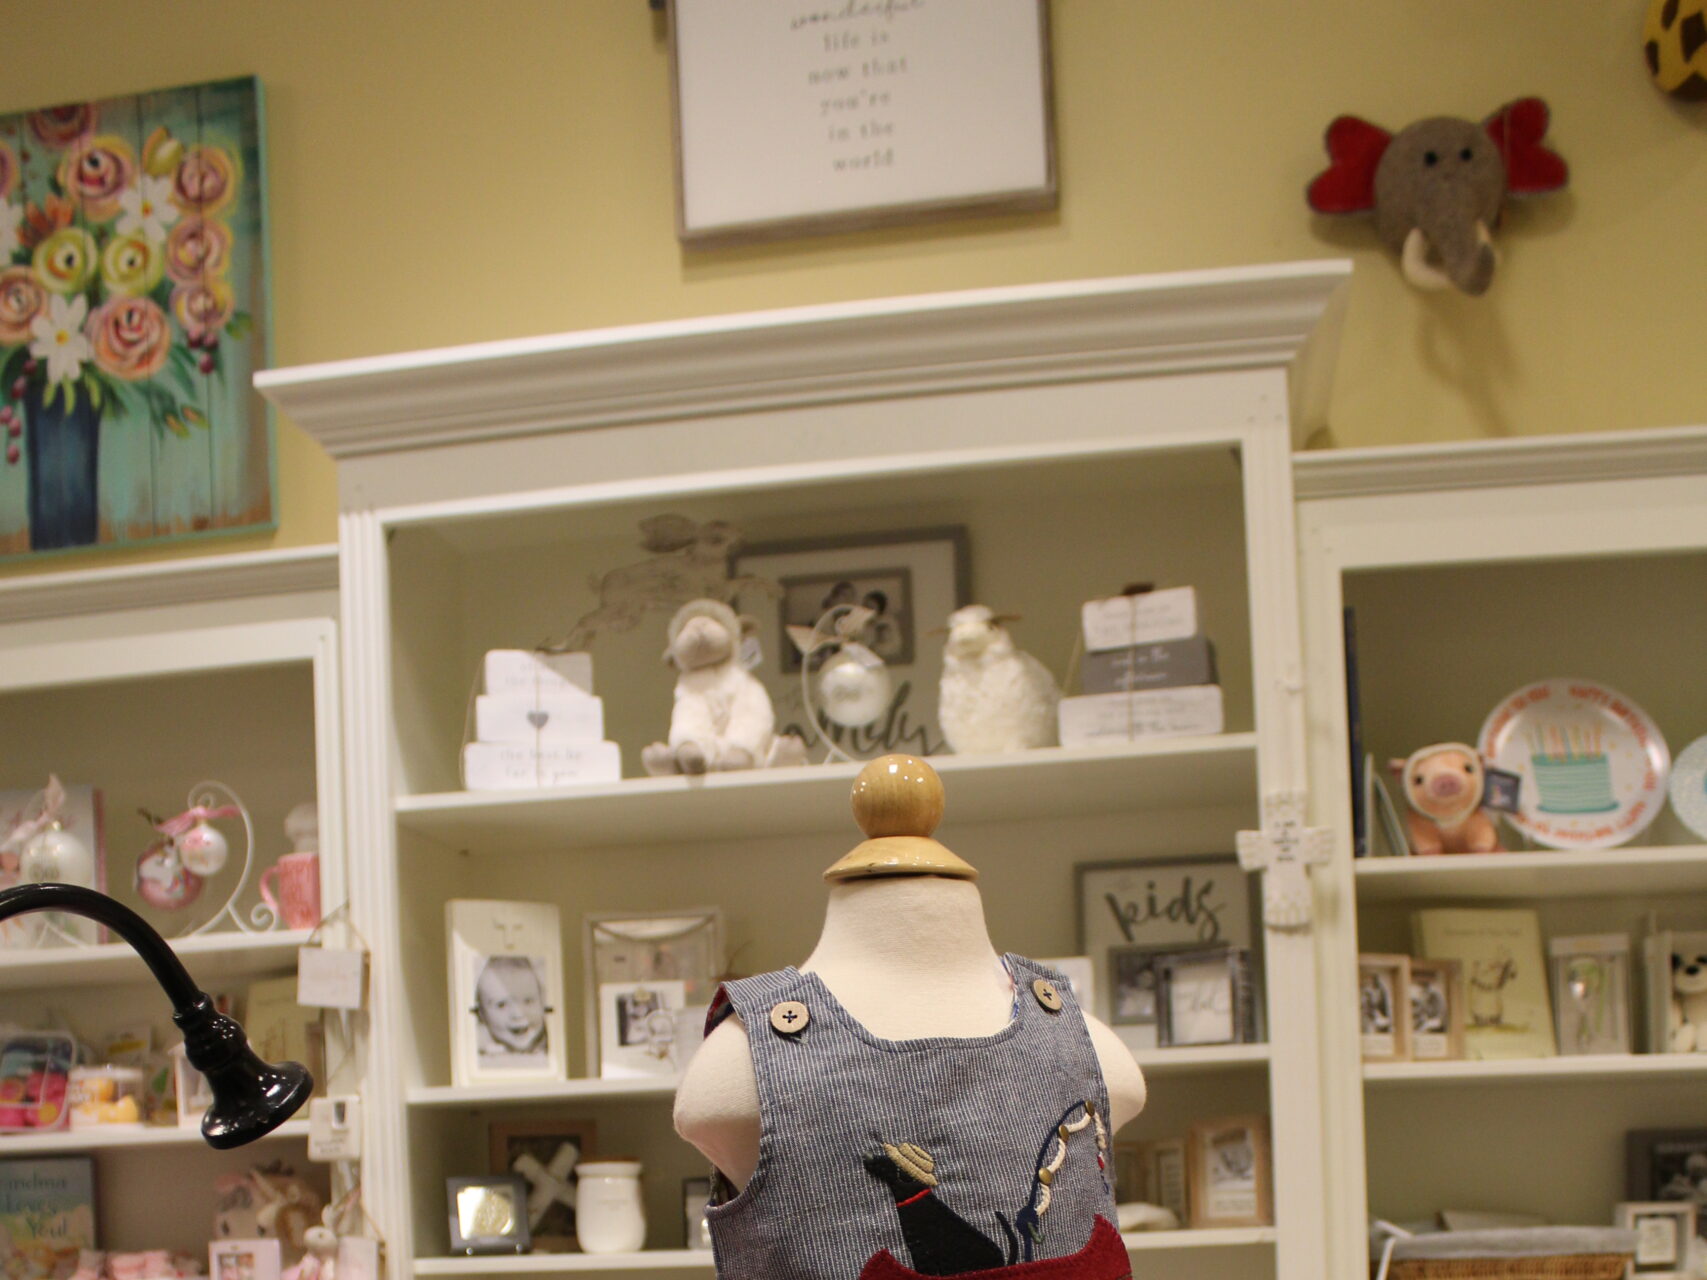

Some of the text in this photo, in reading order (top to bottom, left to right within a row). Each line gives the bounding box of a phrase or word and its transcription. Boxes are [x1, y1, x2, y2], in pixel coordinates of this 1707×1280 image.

[789, 0, 922, 31] wonderfu
[808, 56, 908, 84] now that
[859, 117, 894, 138] the
[832, 147, 894, 170] world
[1104, 876, 1226, 945] kids
